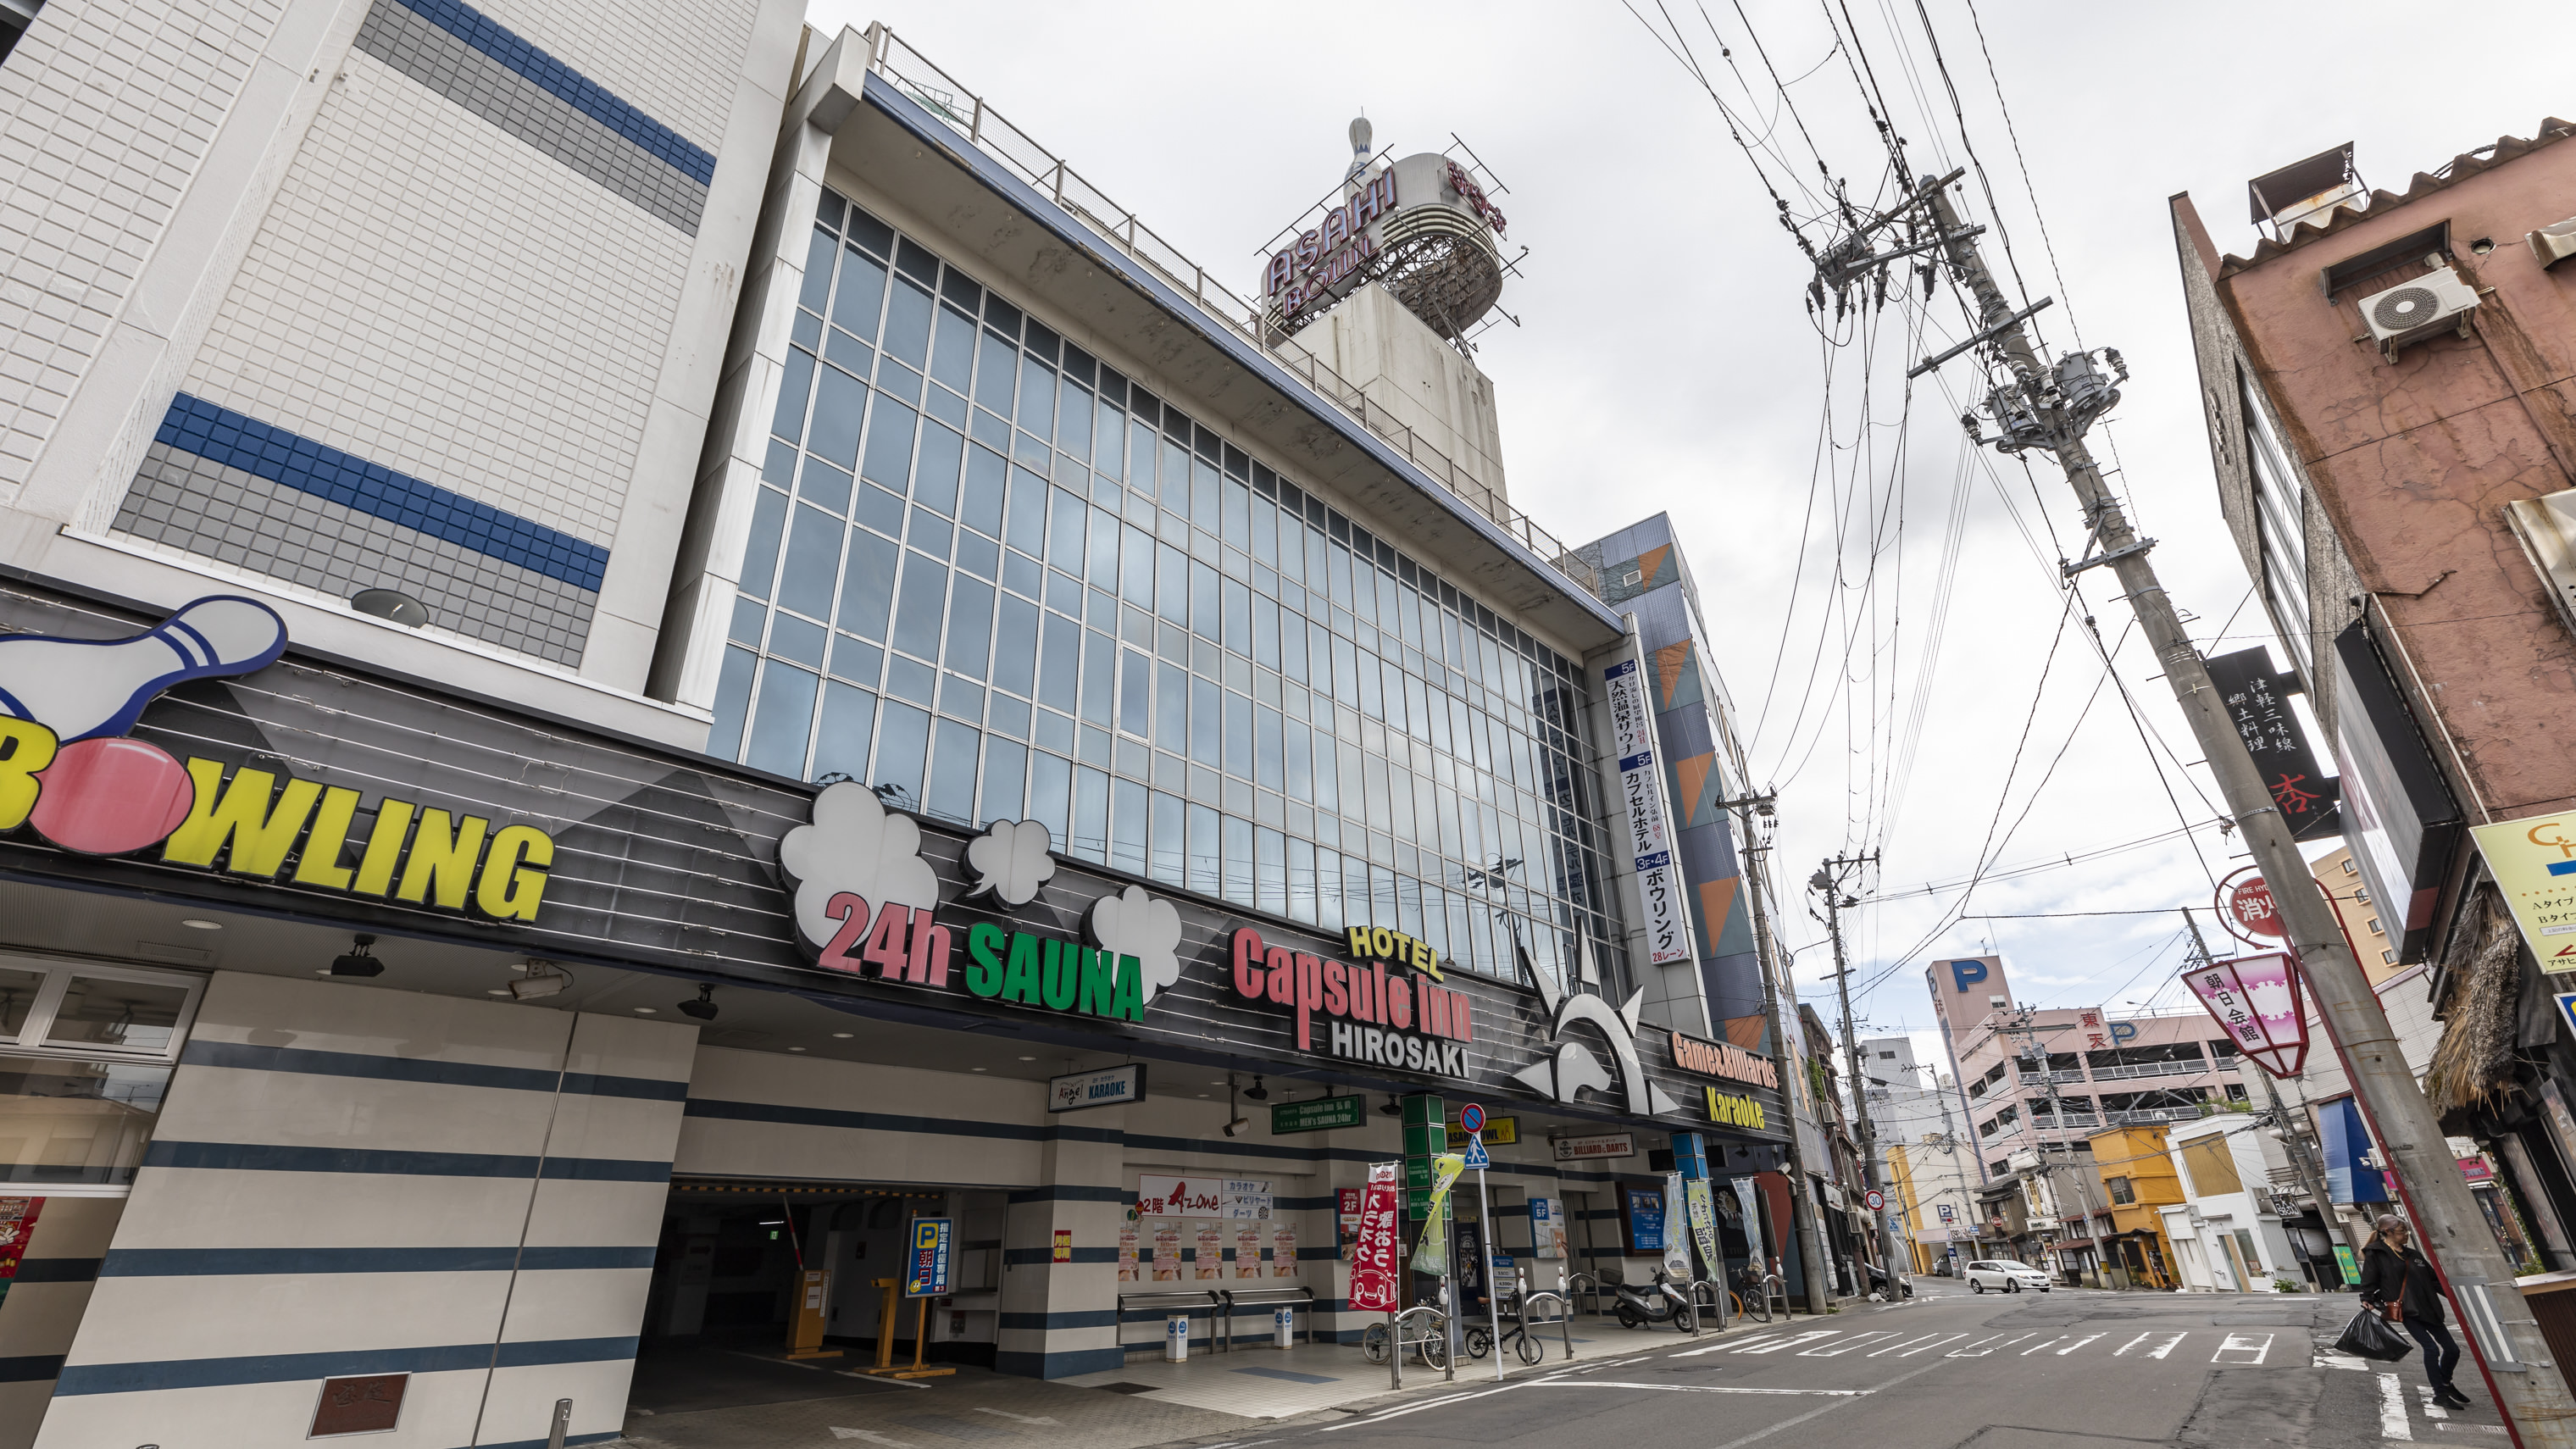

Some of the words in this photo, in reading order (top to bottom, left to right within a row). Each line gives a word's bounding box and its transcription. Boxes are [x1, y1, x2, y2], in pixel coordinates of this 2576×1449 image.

[1268, 165, 1396, 297] ASAHI
[1284, 233, 1380, 317] BOWL
[1621, 663, 1635, 674] 5F
[1609, 678, 1636, 756] 天然温泉サウナ
[2228, 691, 2269, 752] 郷土料理
[2250, 678, 2296, 754] 津軽三味線
[1637, 754, 1652, 766] 5F
[2269, 774, 2321, 815] 杏
[1626, 772, 1652, 852] カプセルホテル
[2238, 886, 2254, 895] FIRE
[1646, 868, 1674, 951] ボウリング
[2236, 895, 2275, 922] 消火
[817, 891, 952, 989] 24h
[963, 922, 1146, 1023] SAUNA
[1349, 925, 1445, 983] HOTEL
[1652, 947, 1685, 963] 28レーン
[1951, 959, 1988, 992] P
[1233, 927, 1412, 1051] Capsule
[2204, 971, 2261, 1043] 朝日会館
[2108, 1022, 2138, 1047] P
[1330, 1020, 1470, 1080] HIROSAKI
[1058, 1084, 1084, 1106] Angel
[1088, 1080, 1126, 1100] KARAOKE
[1299, 1103, 1324, 1115] Capsule
[1317, 1114, 1337, 1126] SAUNA
[1706, 1085, 1765, 1130] Karaoke
[1447, 1131, 1472, 1143] ASAH
[1480, 1129, 1499, 1141] OWL
[1230, 1181, 1255, 1191] カラオケ
[1143, 1197, 1163, 1215] 2階
[1233, 1208, 1252, 1219] ダーツ
[1242, 1196, 1272, 1206] ビリヤード
[1344, 1201, 1357, 1212] 2F
[1535, 1208, 1546, 1218] 5F
[1869, 1196, 1881, 1206] 30
[1938, 1205, 1951, 1217] P
[919, 1225, 936, 1246] P
[935, 1223, 949, 1285] 指定月極専用
[919, 1249, 935, 1286] 朝日
